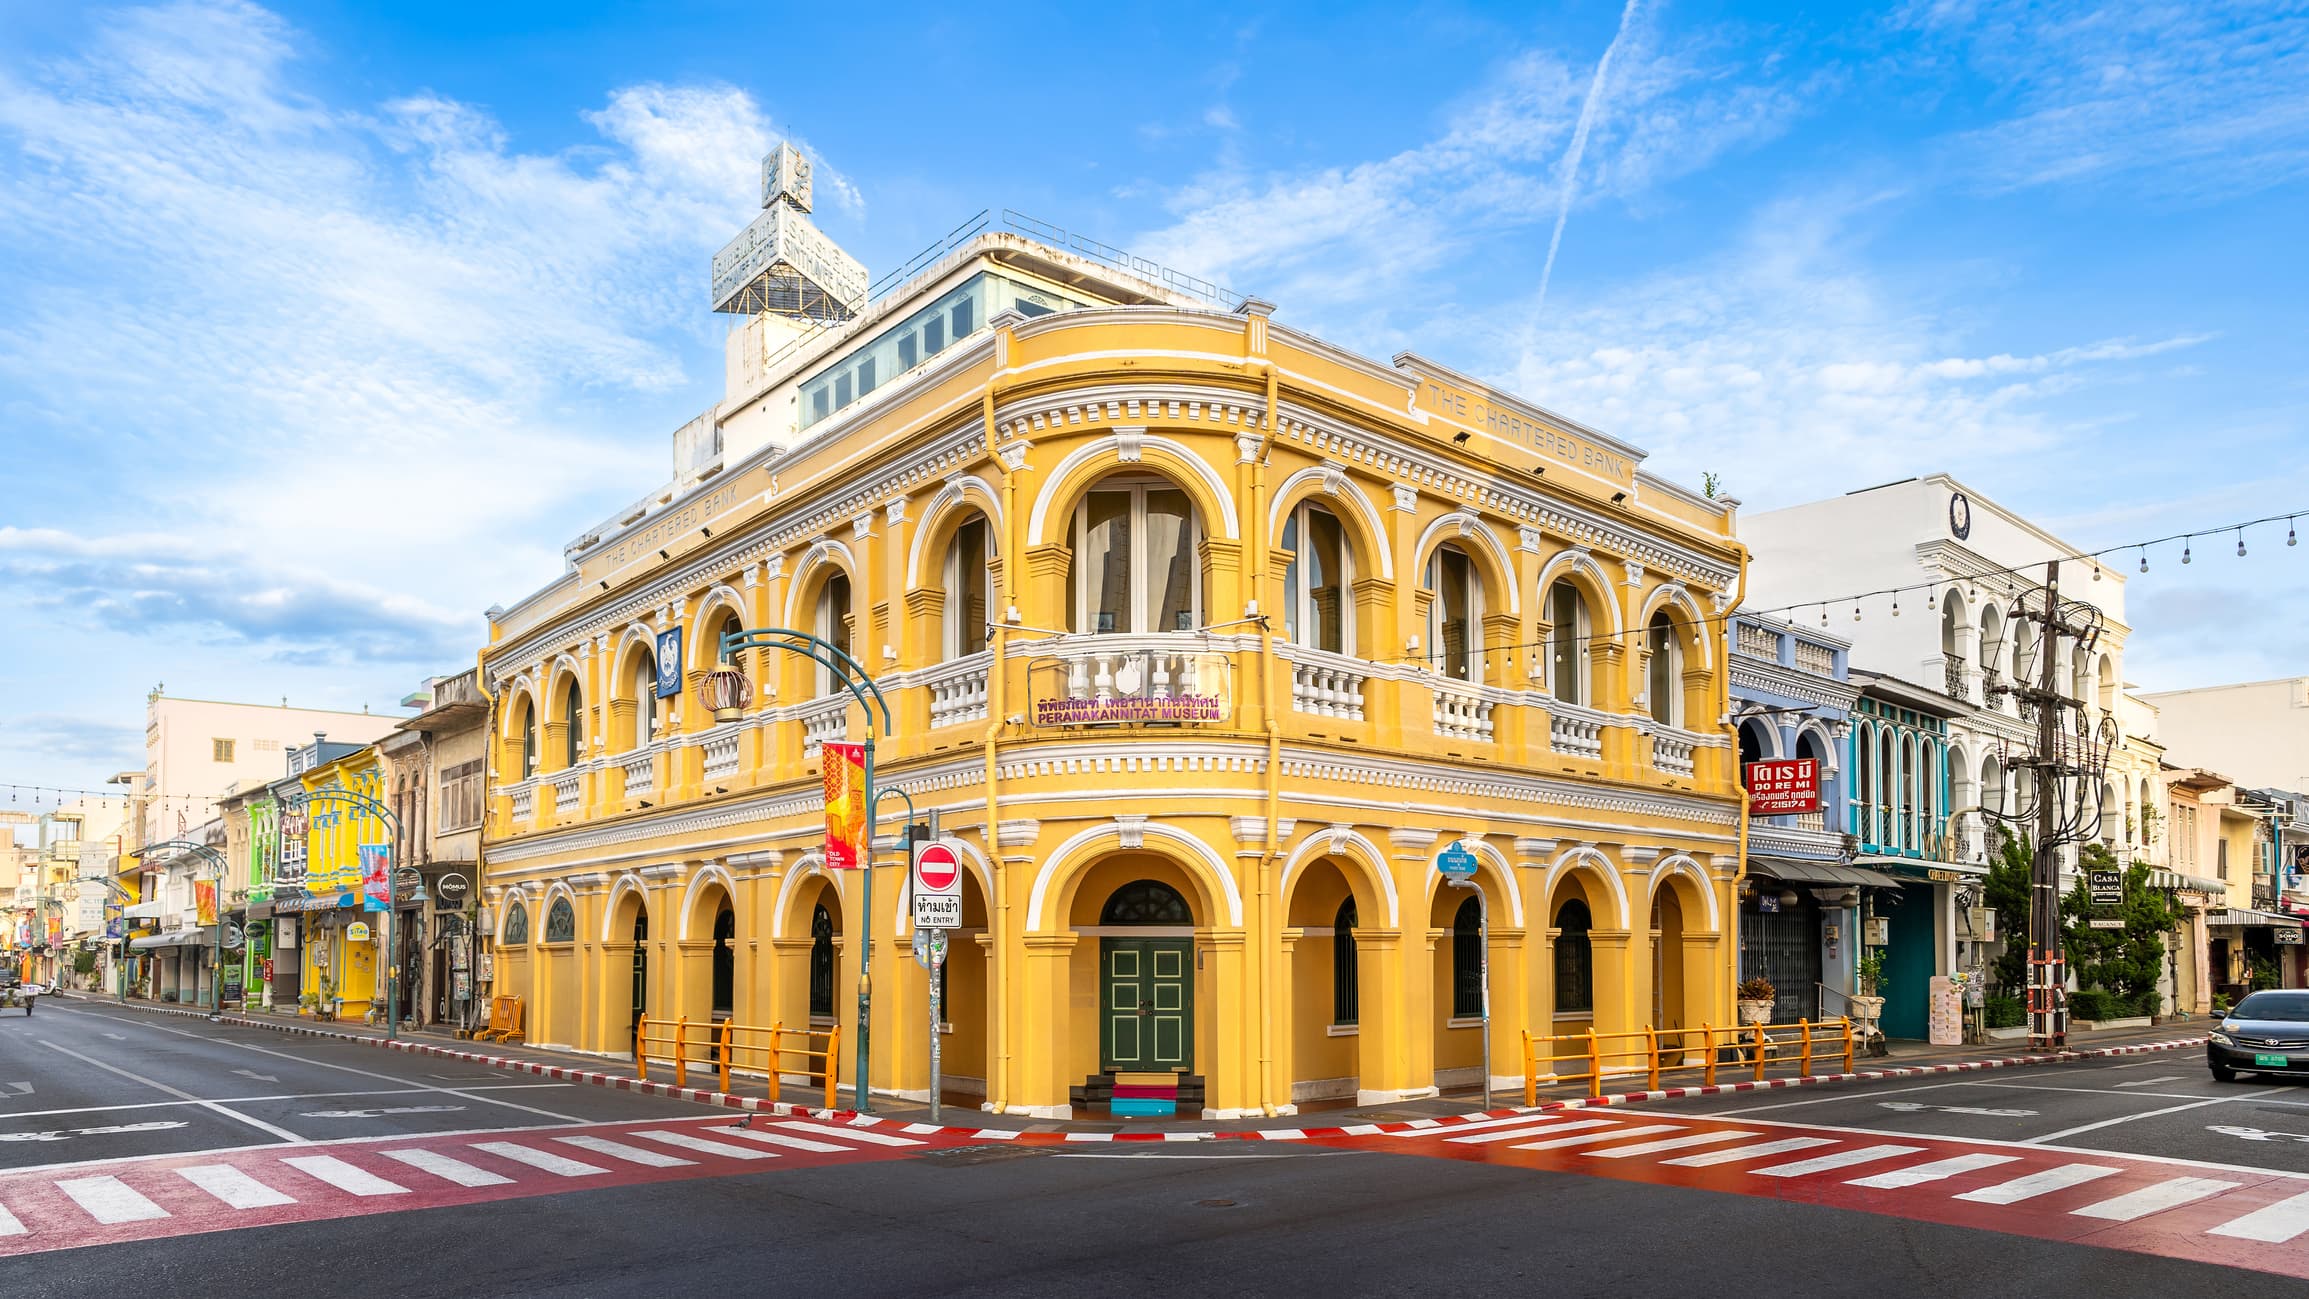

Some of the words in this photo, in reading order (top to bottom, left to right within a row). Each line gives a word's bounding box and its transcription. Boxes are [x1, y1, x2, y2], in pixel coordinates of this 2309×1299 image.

[1429, 384, 1467, 417] THE
[1474, 404, 1577, 460] CHARTERED
[1583, 447, 1625, 479] BANK
[606, 547, 625, 568] THE
[630, 508, 698, 555] CHARTERED
[704, 484, 737, 517] BANK
[1037, 694, 1100, 713] พิพิธภัณฑ์
[1037, 708, 1158, 724] PERANAKANNITAT
[1161, 708, 1220, 721] MUSEUM
[1755, 783, 1771, 791] DO
[1775, 781, 1793, 790] RE
[1796, 780, 1810, 789] MI
[917, 897, 958, 913] ห้ามเข้า
[921, 916, 931, 924] NO
[933, 916, 954, 924] ENTRY
